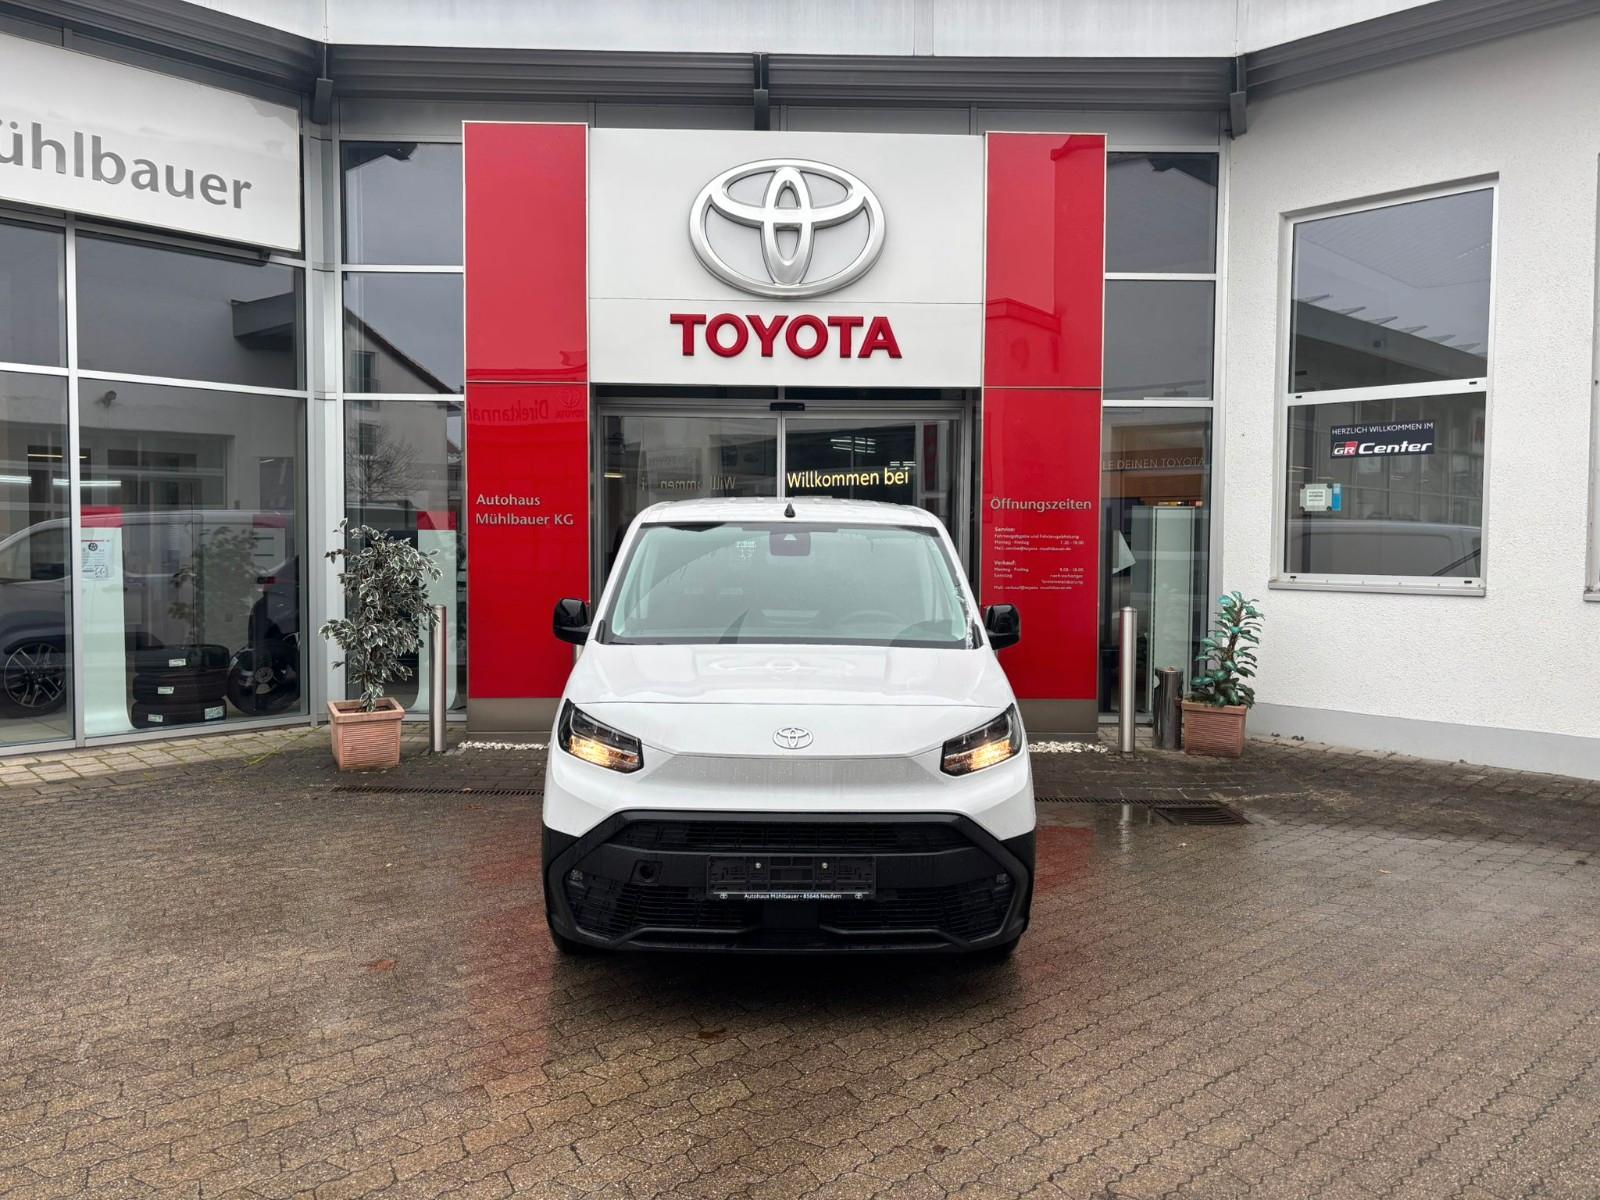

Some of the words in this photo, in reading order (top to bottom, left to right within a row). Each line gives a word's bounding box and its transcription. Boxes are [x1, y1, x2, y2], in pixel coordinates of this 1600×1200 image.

[670, 313, 902, 360] TOYOTA
[1331, 425, 1368, 436] HERZLICH
[1369, 423, 1422, 433] WILLKOMMEN
[1424, 422, 1434, 430] IM
[1333, 446, 1355, 455] GR
[1358, 440, 1433, 454] Center
[1116, 458, 1158, 470] DEINEN
[1160, 456, 1206, 468] TOYOTA
[787, 470, 880, 489] Willkommen
[884, 466, 910, 486] bei
[476, 493, 541, 506] Autohaus
[990, 496, 1092, 513] Öffnungszeiten
[476, 512, 550, 525] Mühlbauer
[553, 513, 575, 525] KG
